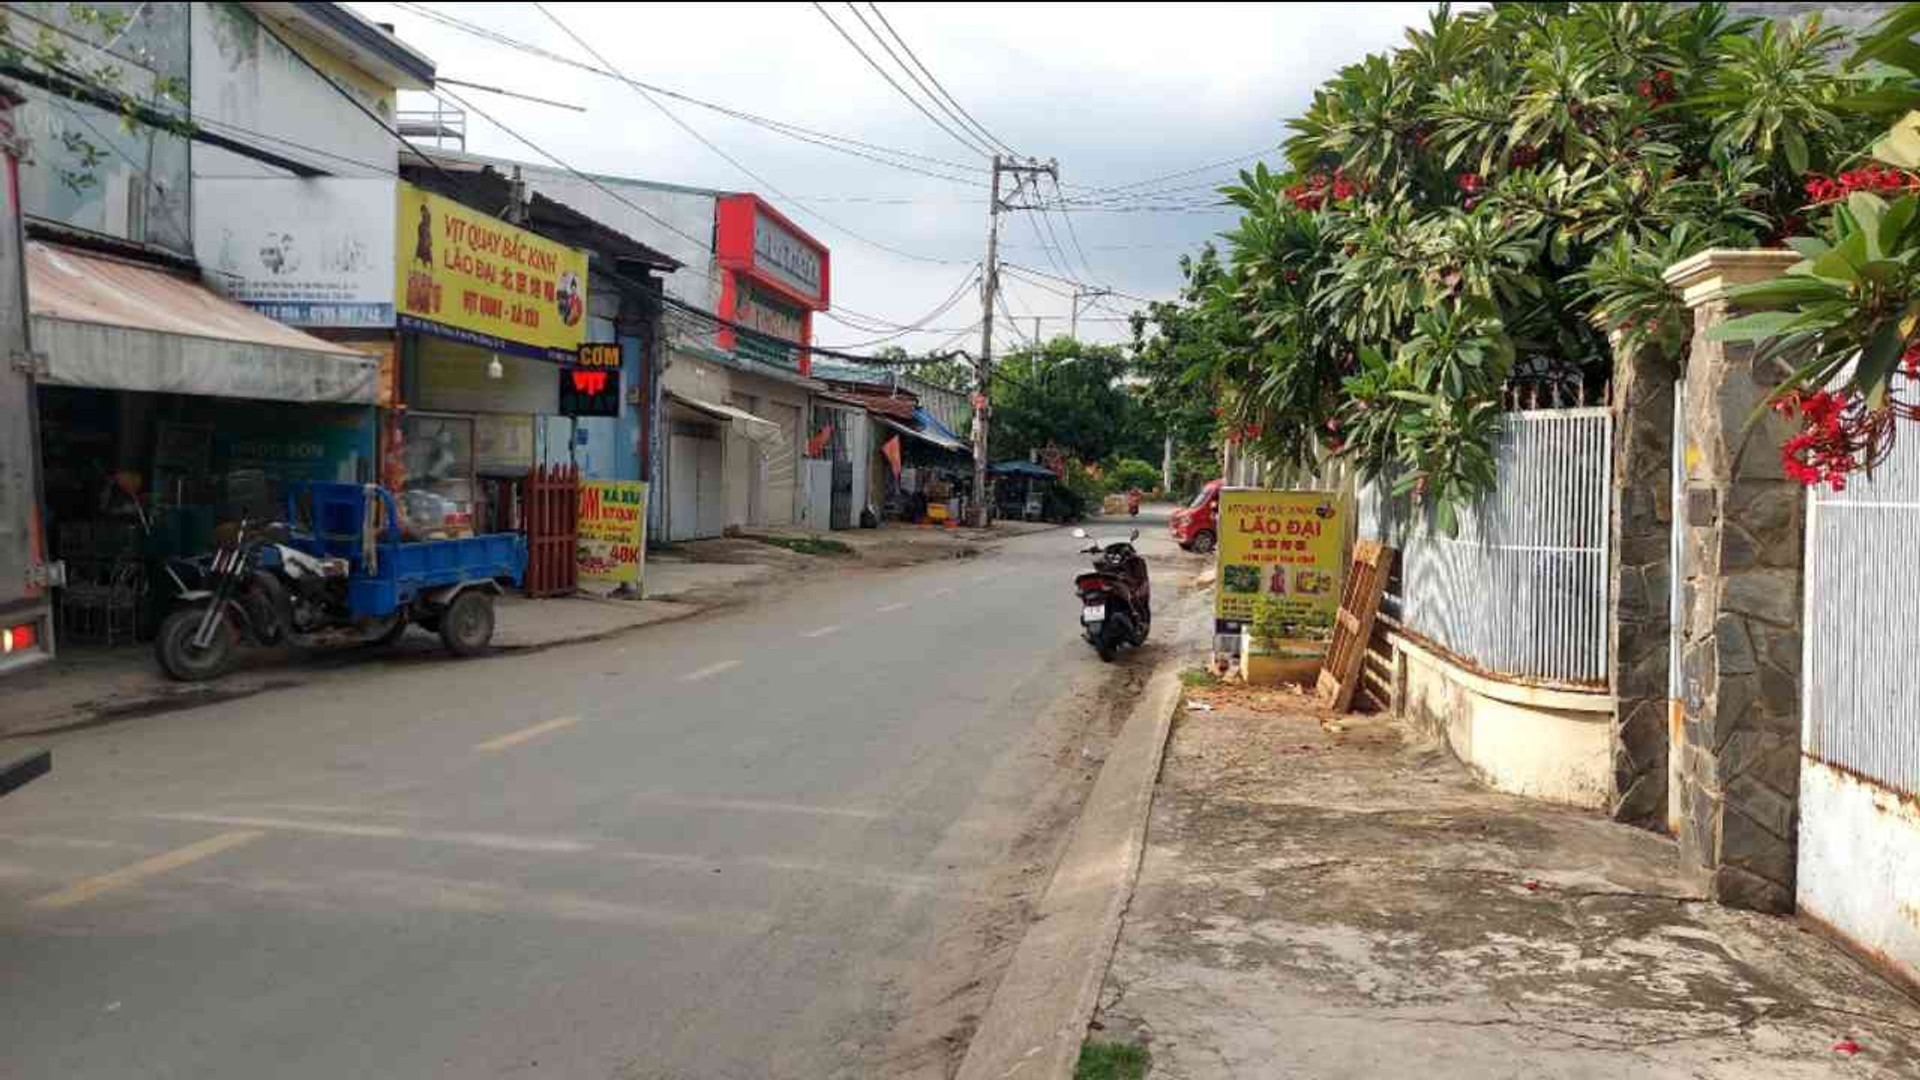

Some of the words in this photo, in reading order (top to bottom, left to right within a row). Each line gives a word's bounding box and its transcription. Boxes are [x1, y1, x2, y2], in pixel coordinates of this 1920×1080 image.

[467, 225, 501, 255] QUAY
[527, 247, 557, 276] KINH
[1240, 515, 1281, 535] LÃO
[1286, 519, 1321, 540] ĐẠI
